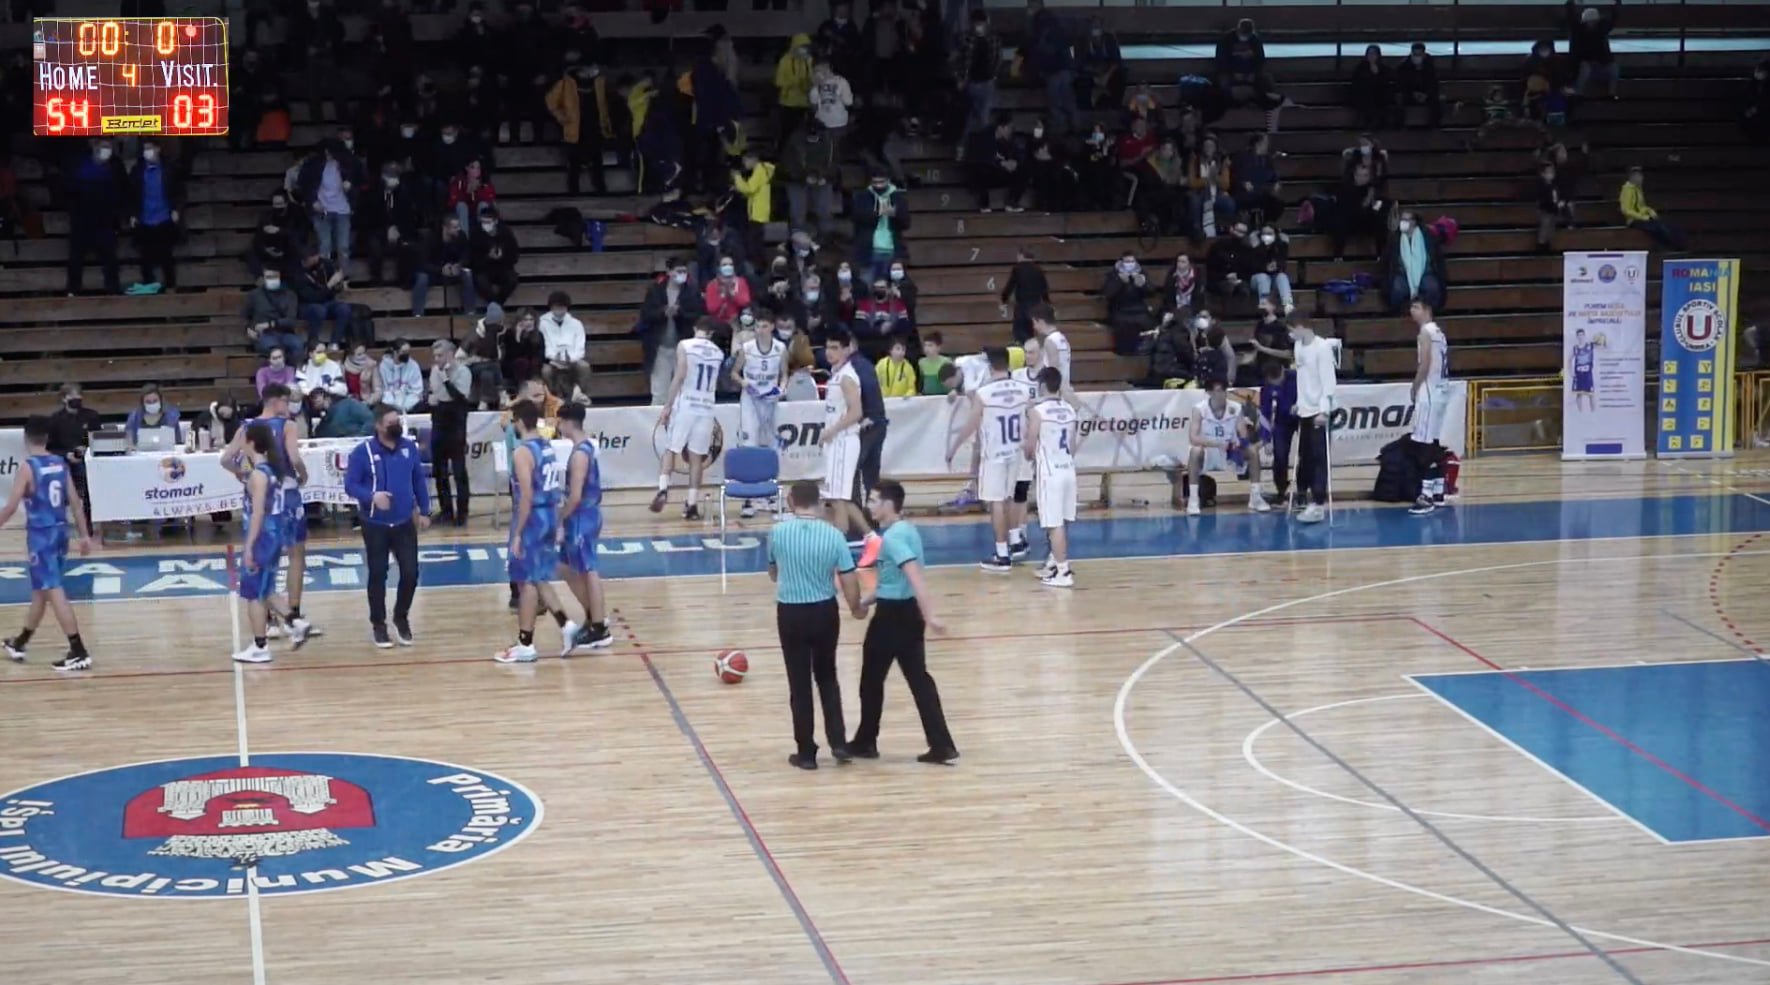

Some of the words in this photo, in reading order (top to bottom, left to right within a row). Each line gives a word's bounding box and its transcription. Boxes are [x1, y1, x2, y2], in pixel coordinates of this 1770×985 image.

[970, 248, 980, 261] 7
[987, 277, 995, 290] 6
[1689, 281, 1716, 293] IASI
[1686, 314, 1712, 341] U
[1029, 387, 1037, 399] 9
[996, 413, 1021, 445] 10
[49, 479, 62, 508] 6
[145, 483, 204, 500] stomart
[153, 503, 213, 517] ALWAYS
[426, 773, 522, 853] Primăria
